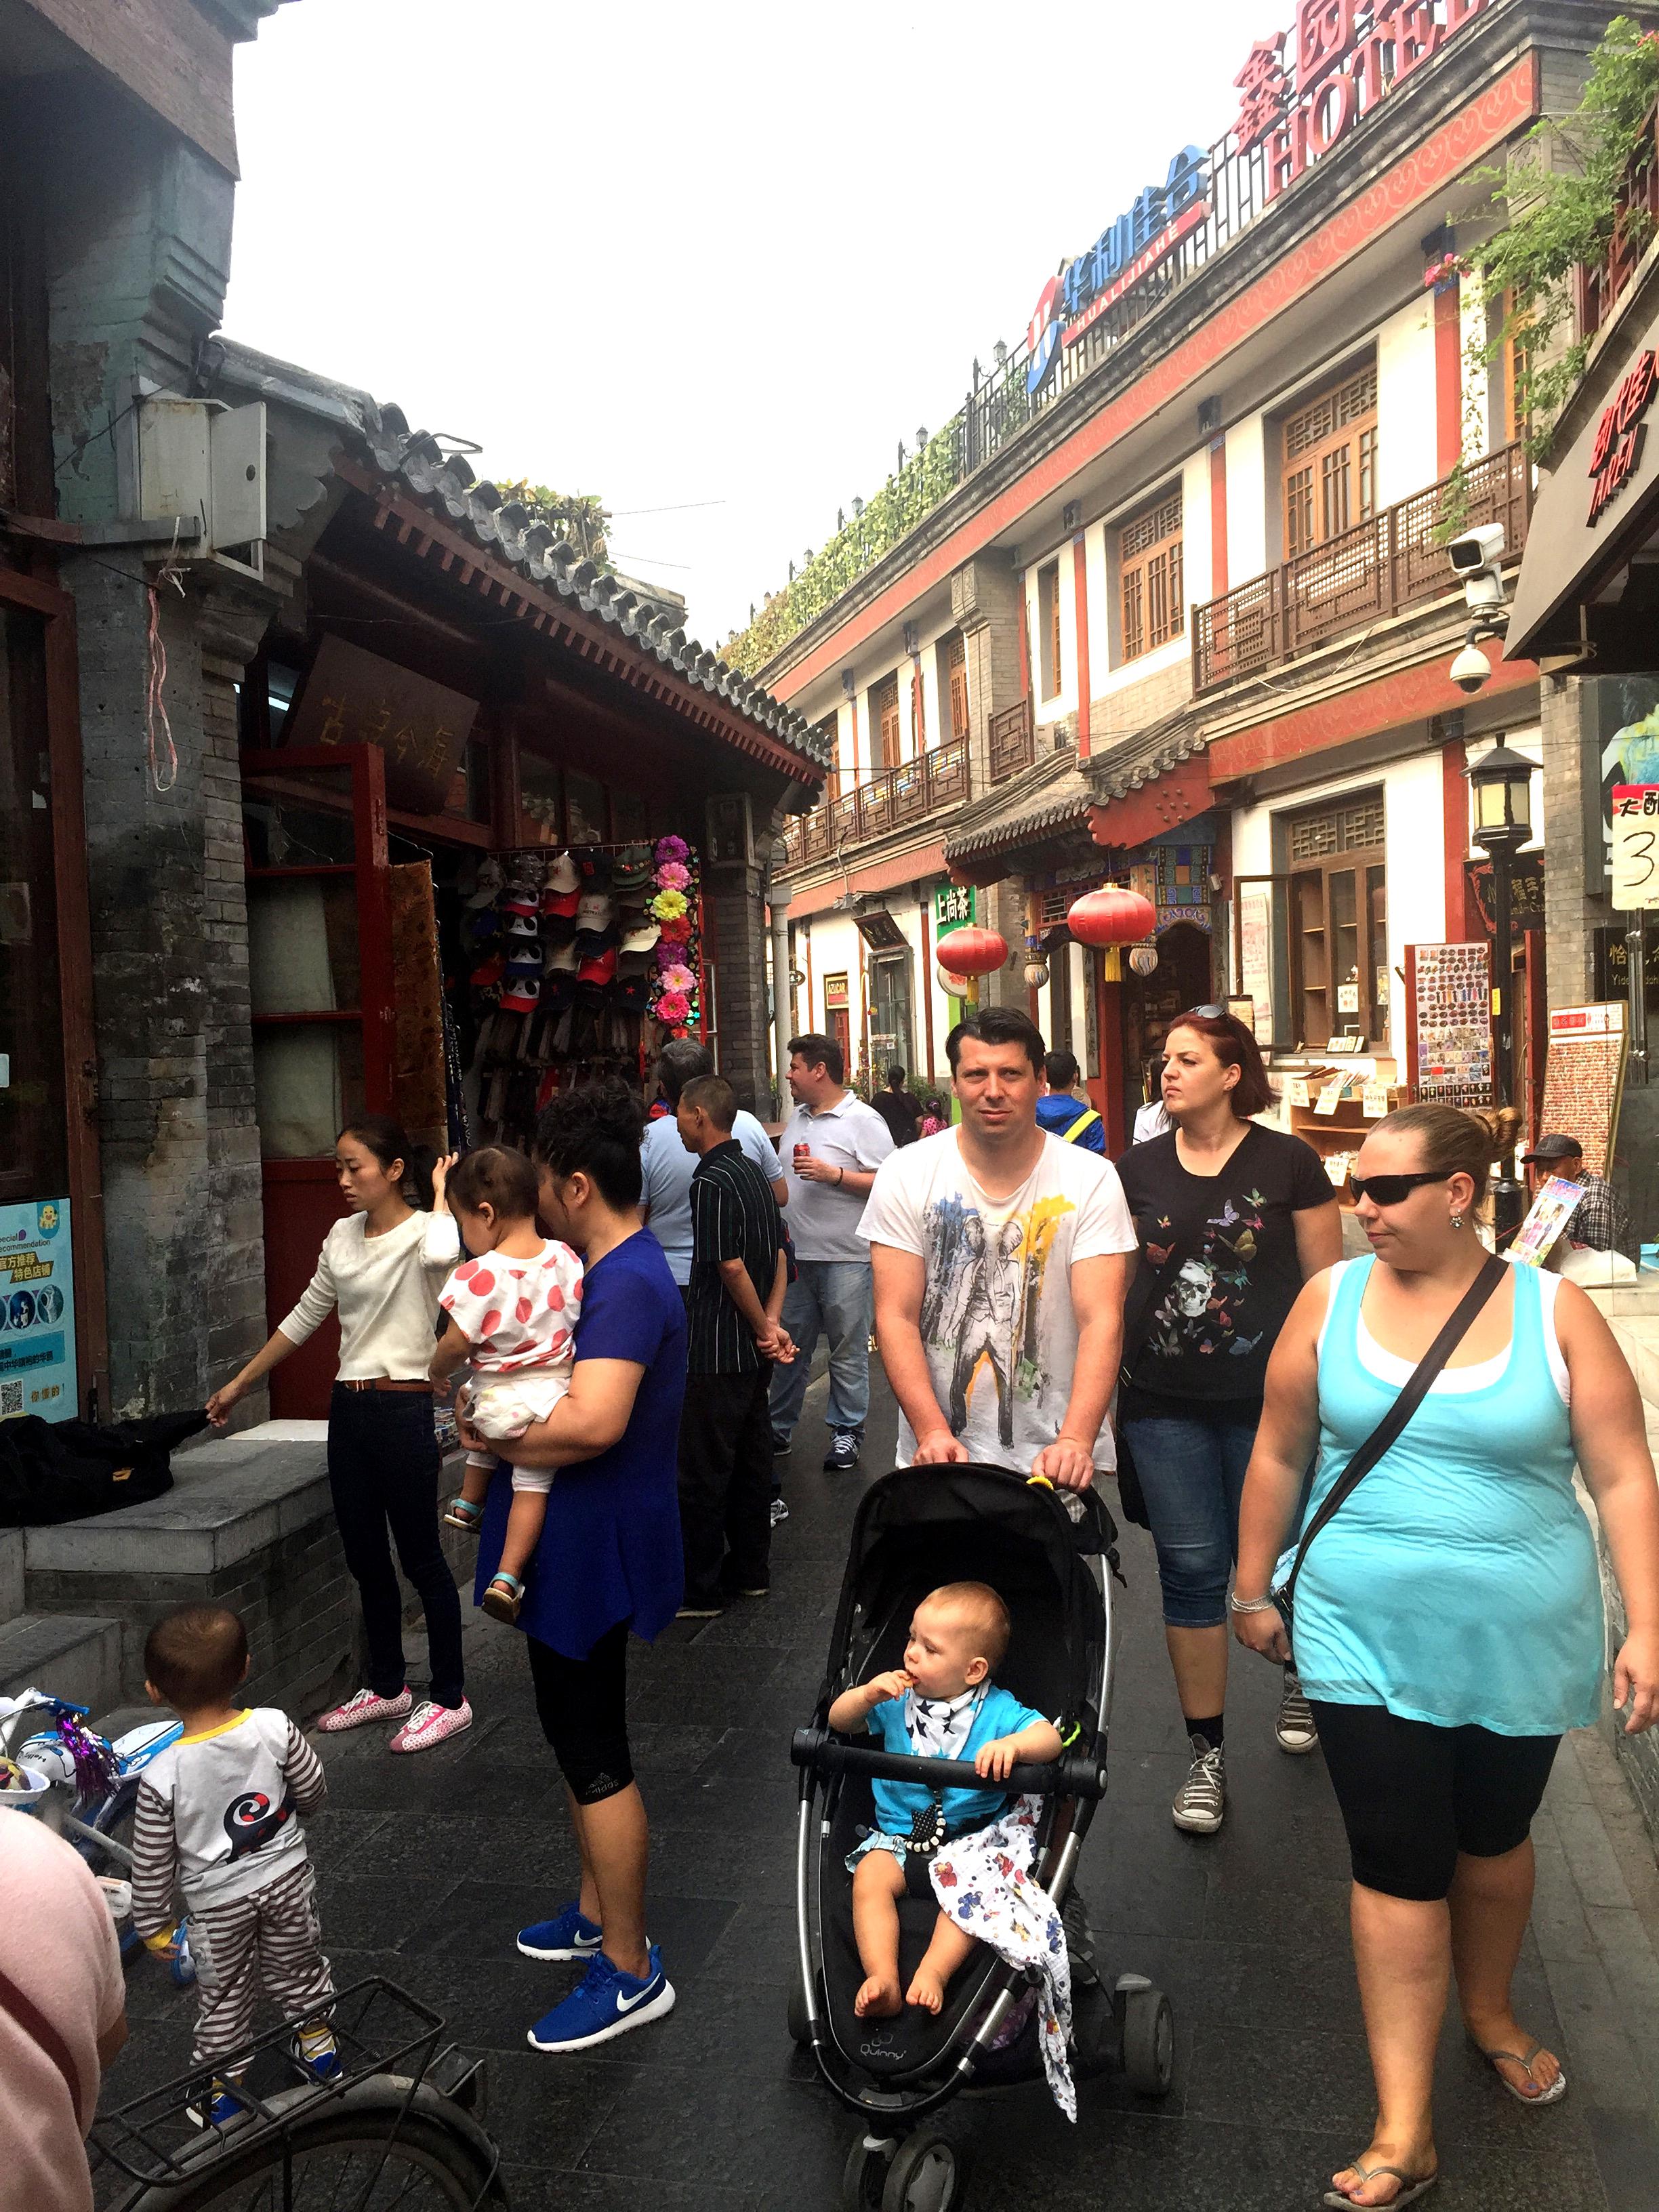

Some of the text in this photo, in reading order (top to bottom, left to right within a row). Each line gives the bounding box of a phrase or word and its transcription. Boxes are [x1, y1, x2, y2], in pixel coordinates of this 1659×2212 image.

[1263, 0, 1488, 206] HOTEL
[1061, 144, 1211, 314] 华利佳合
[1077, 223, 1179, 333] HUALIJIAHE
[937, 886, 968, 925] 上尚茶
[0, 1253, 35, 1270] 官方推荐
[14, 1263, 51, 1281] 特色店铺
[860, 2043, 905, 2061] Quinny
